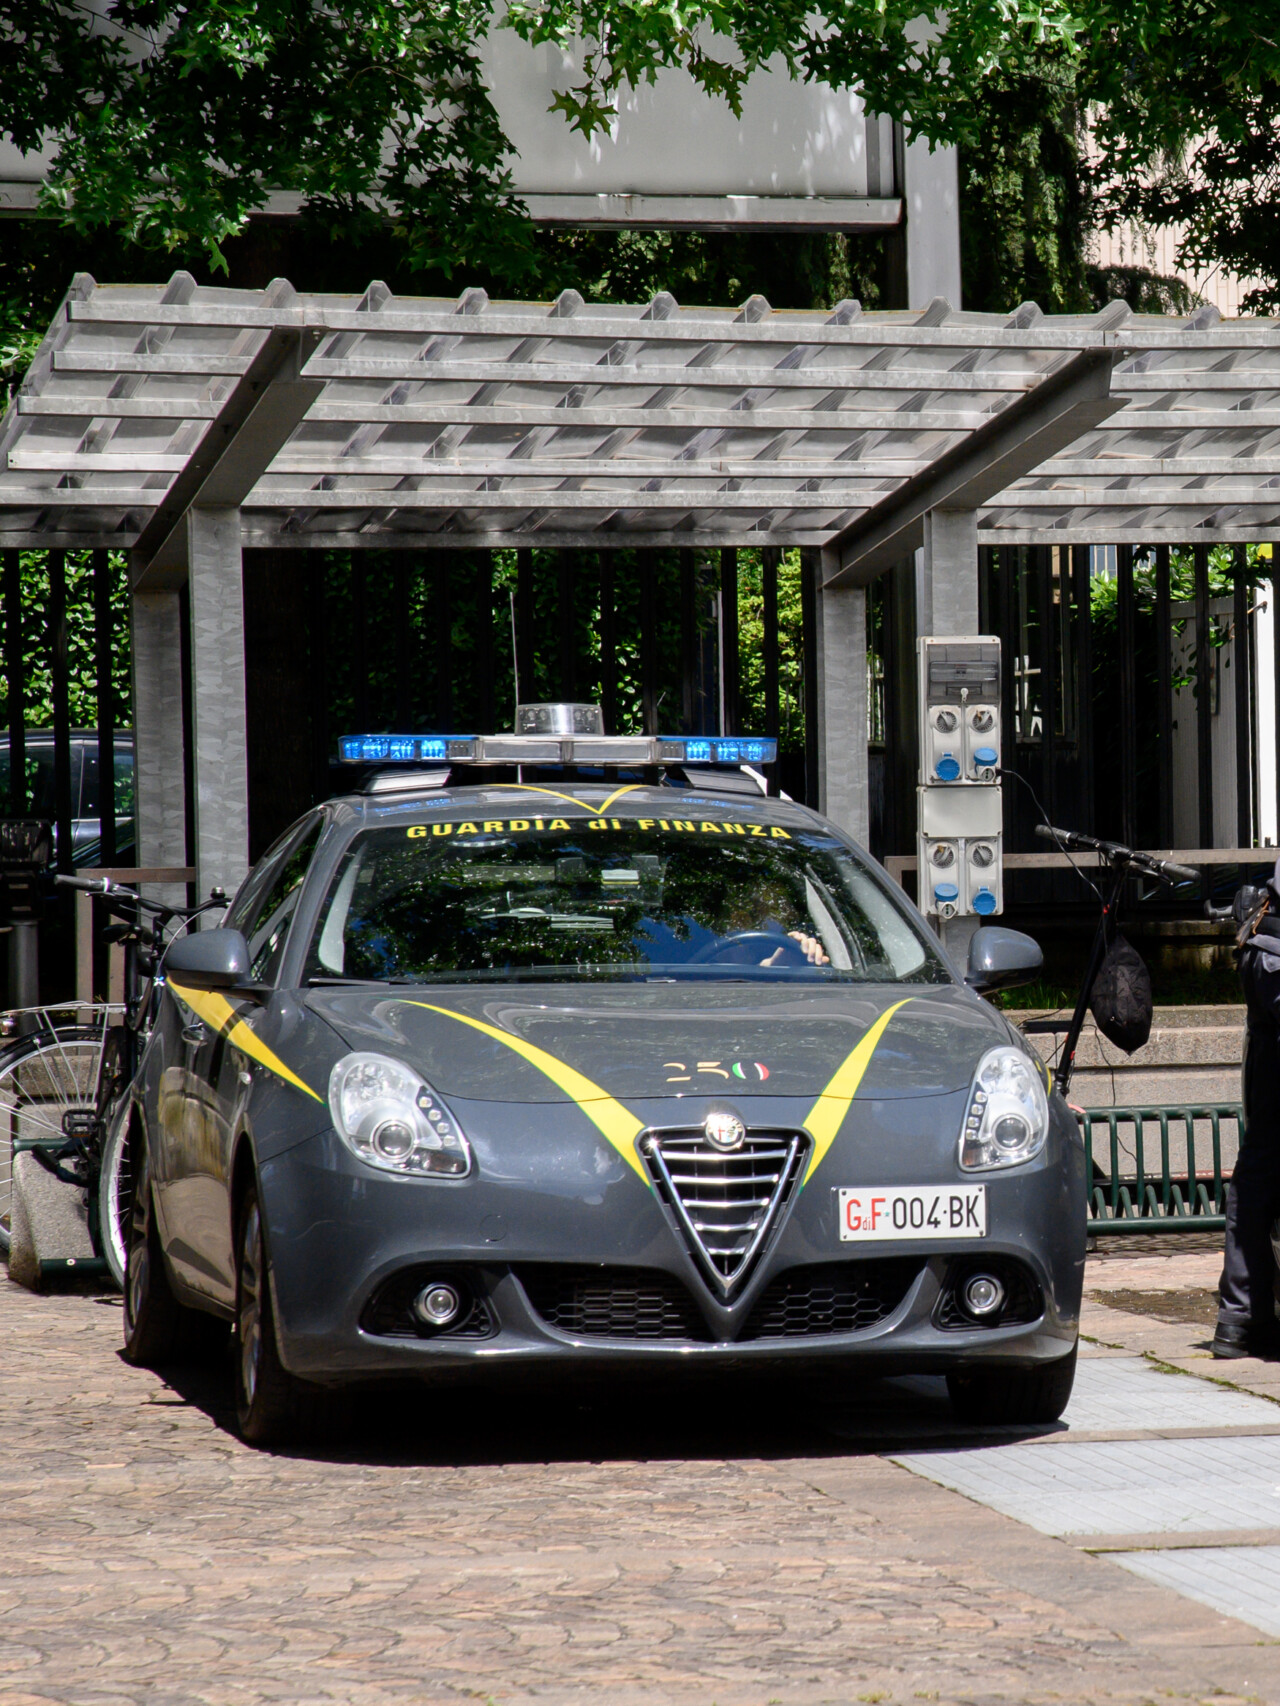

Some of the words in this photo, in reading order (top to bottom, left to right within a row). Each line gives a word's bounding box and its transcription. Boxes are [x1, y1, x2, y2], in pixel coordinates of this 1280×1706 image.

[407, 819, 571, 838] GUARDIA
[588, 819, 622, 831] di
[637, 819, 792, 839] FINANZA
